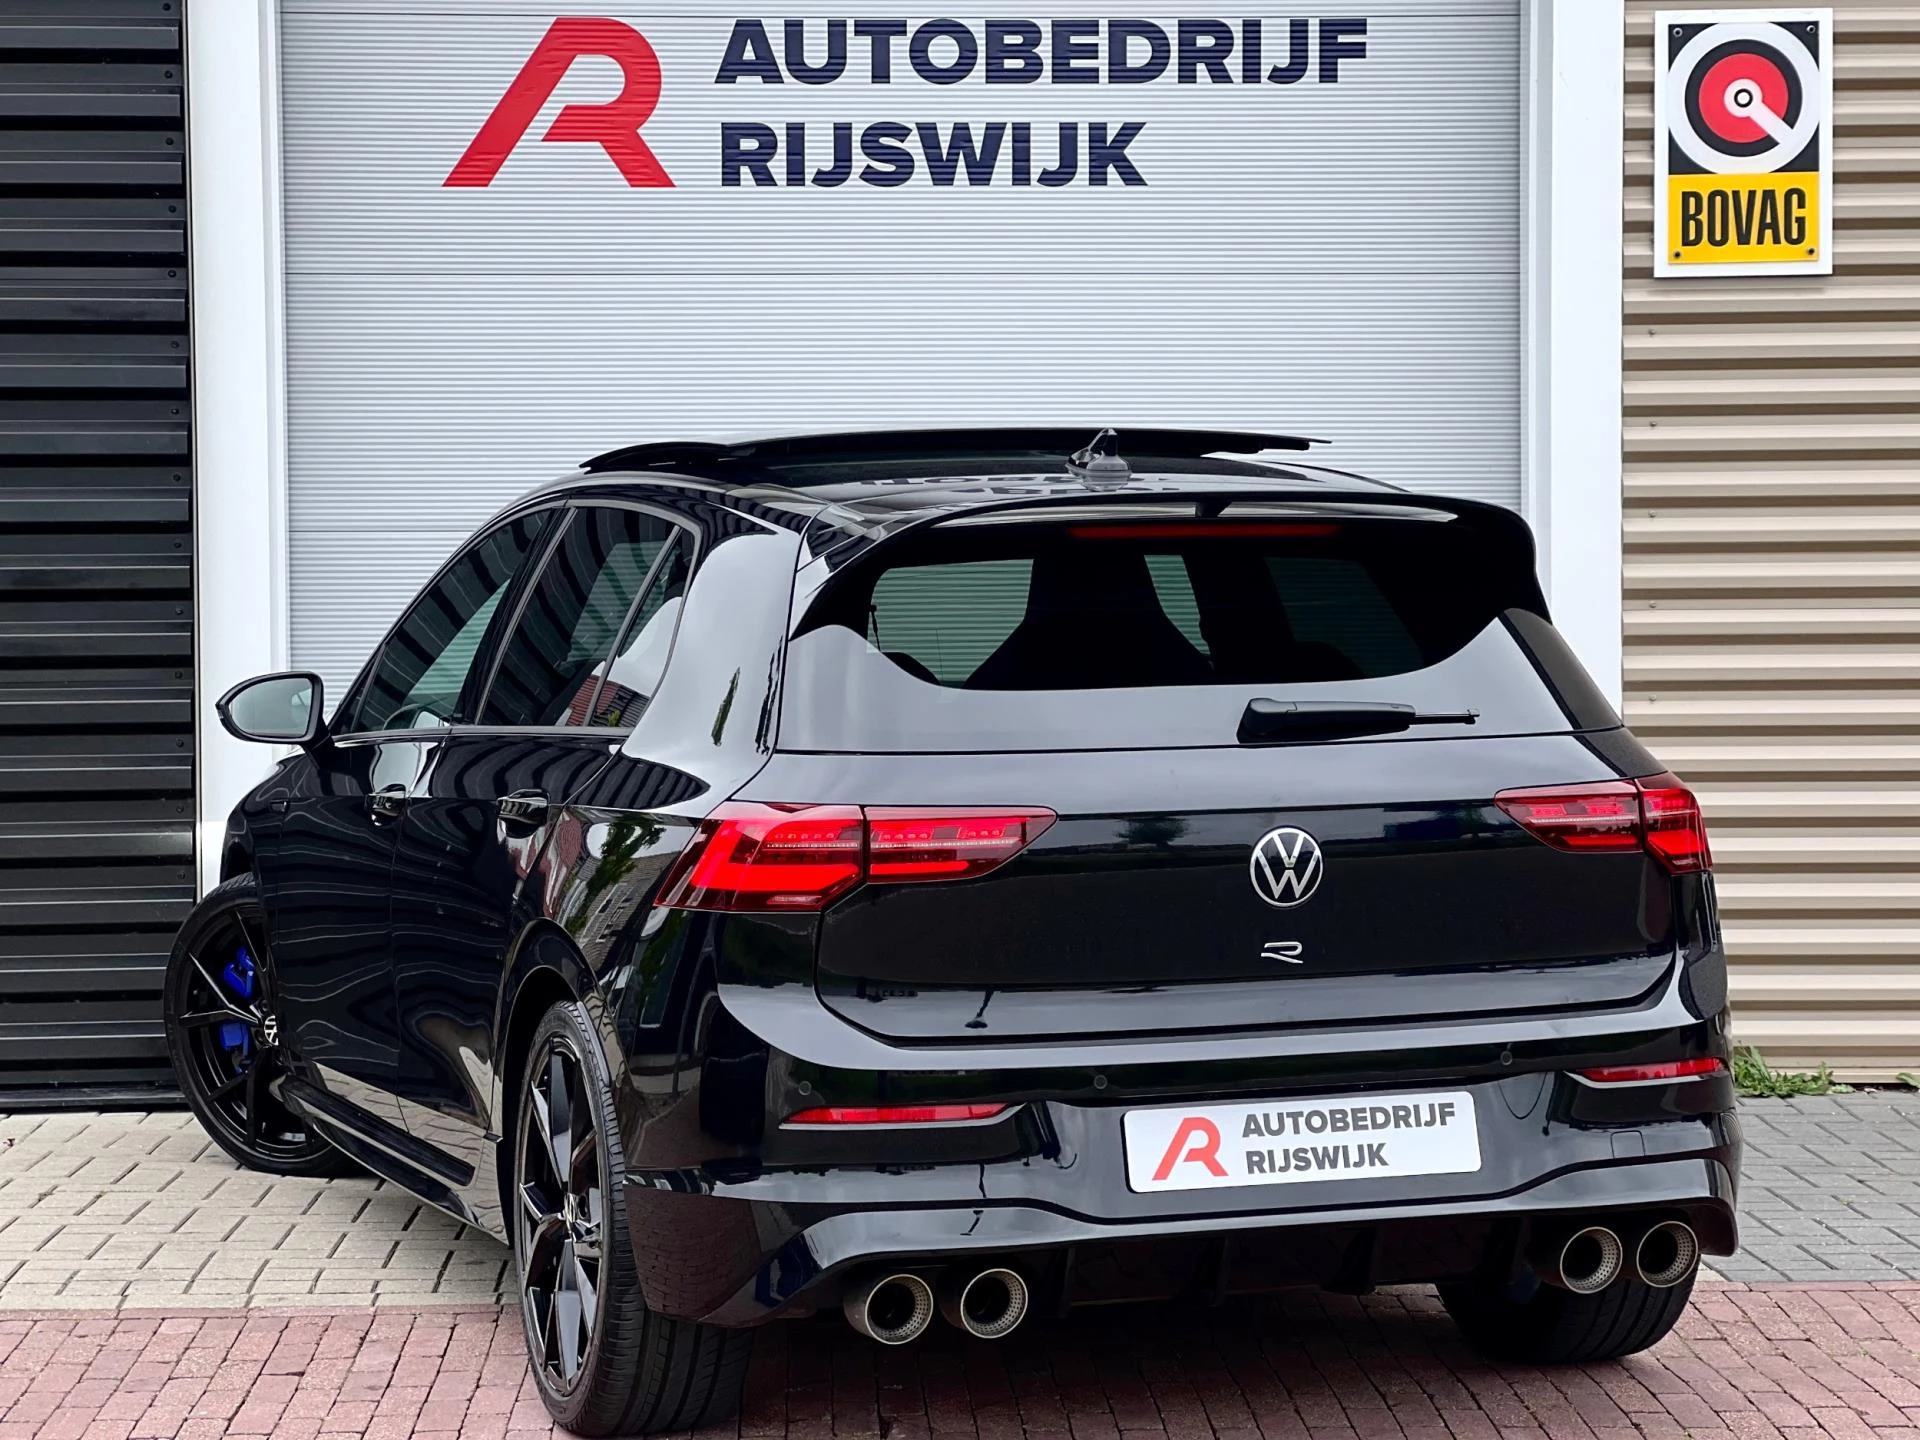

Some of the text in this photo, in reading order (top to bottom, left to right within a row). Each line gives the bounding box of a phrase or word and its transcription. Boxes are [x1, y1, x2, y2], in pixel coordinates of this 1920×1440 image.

[714, 18, 1368, 85] AUTOBEDRIJF
[721, 121, 1147, 188] RIJSWIJK
[1681, 187, 1806, 247] BOVAG
[1255, 830, 1321, 901] VW
[1242, 1102, 1456, 1138] AUTOBEDRIJF
[1246, 1143, 1389, 1175] RIJSWIJK
